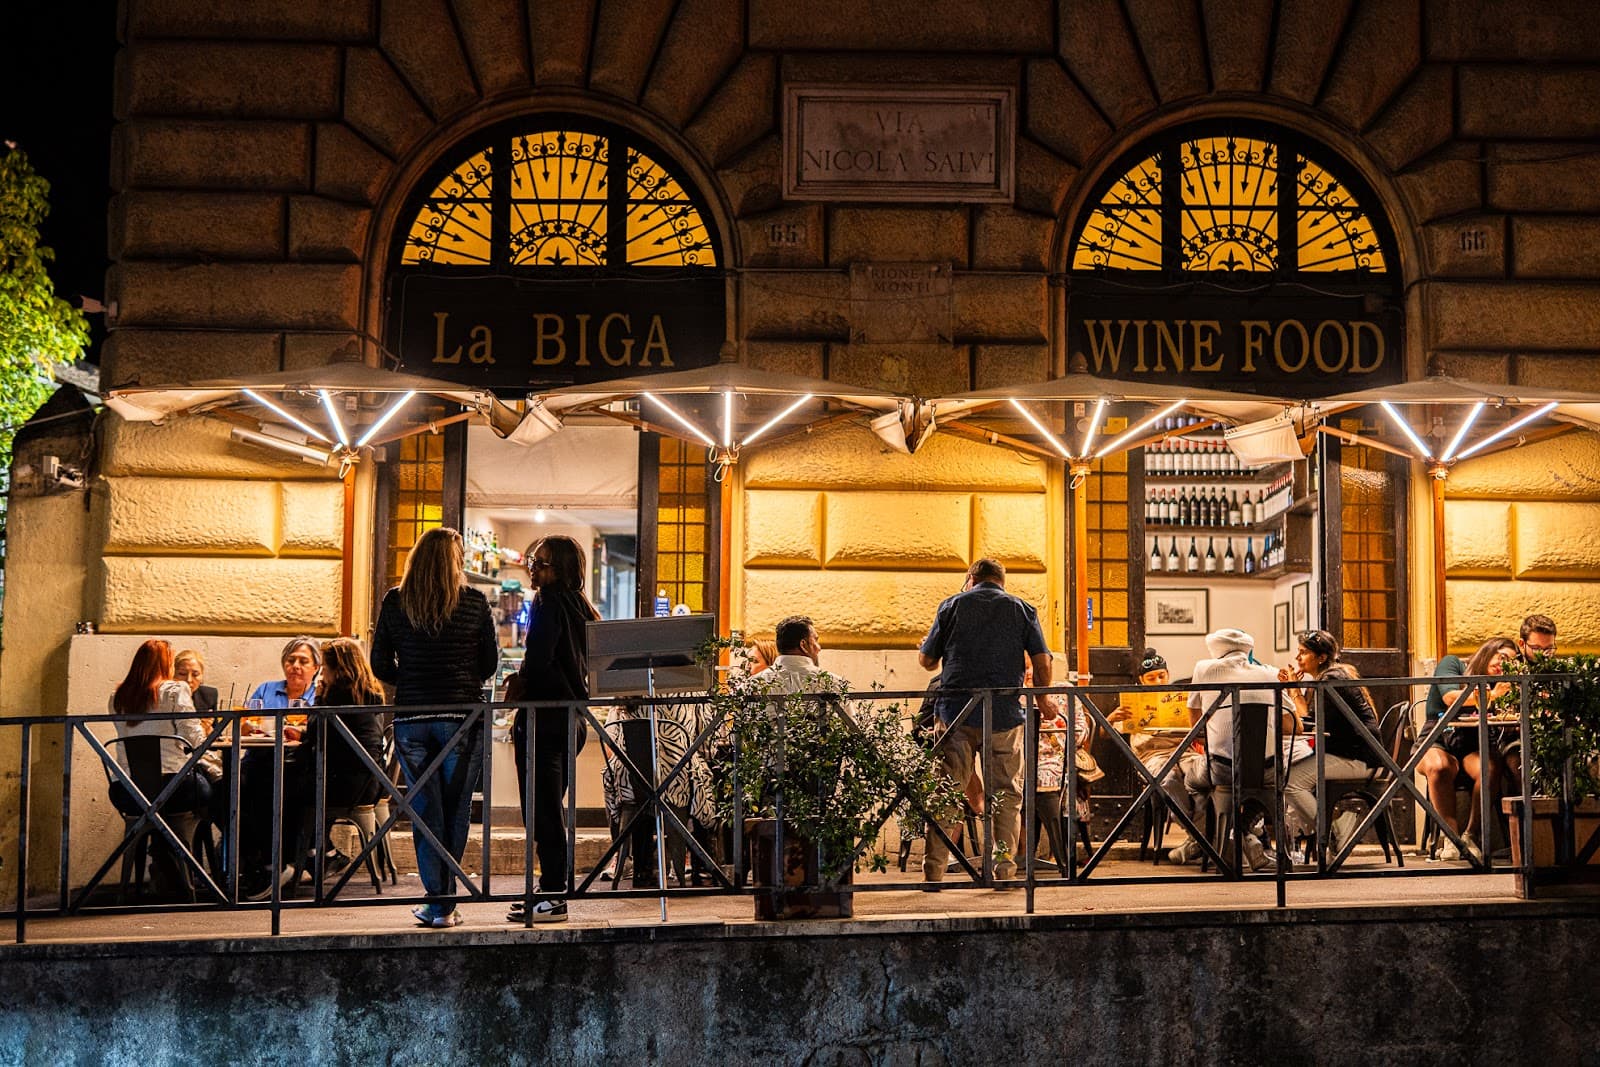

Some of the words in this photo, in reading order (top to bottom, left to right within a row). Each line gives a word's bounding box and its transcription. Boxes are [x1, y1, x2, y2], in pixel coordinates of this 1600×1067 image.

[876, 111, 925, 133] VIA
[804, 150, 907, 172] NICOLA
[925, 151, 993, 173] SALVI
[871, 268, 920, 279] RIONE
[874, 282, 930, 293] MONTI
[431, 312, 497, 364] La
[529, 312, 675, 367] BIGA
[1083, 319, 1225, 374] WINE
[1240, 318, 1386, 374] FOOD
